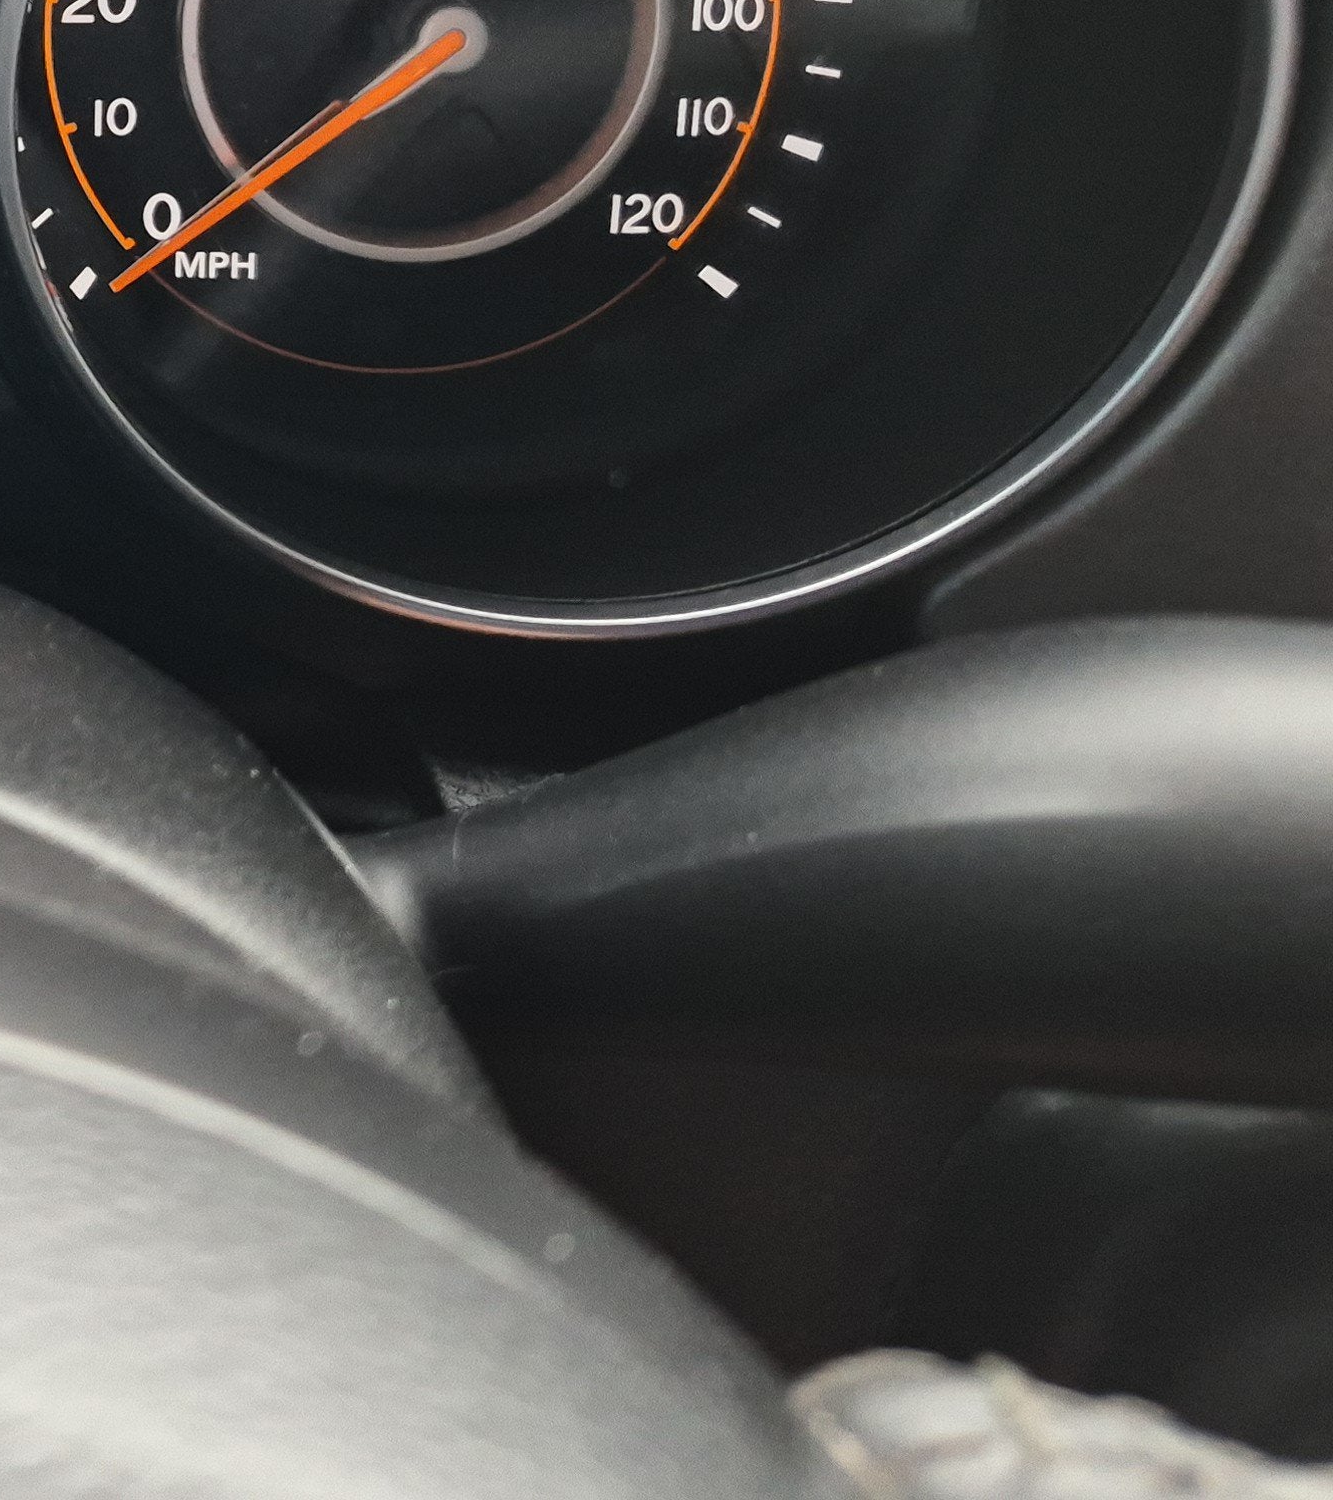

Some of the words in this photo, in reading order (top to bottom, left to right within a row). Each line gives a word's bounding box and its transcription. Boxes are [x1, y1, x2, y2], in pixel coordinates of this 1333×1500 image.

[93, 96, 139, 138] 10
[675, 95, 735, 138] 110
[141, 191, 183, 243] 0
[608, 191, 685, 236] 120
[173, 250, 258, 281] MPH
